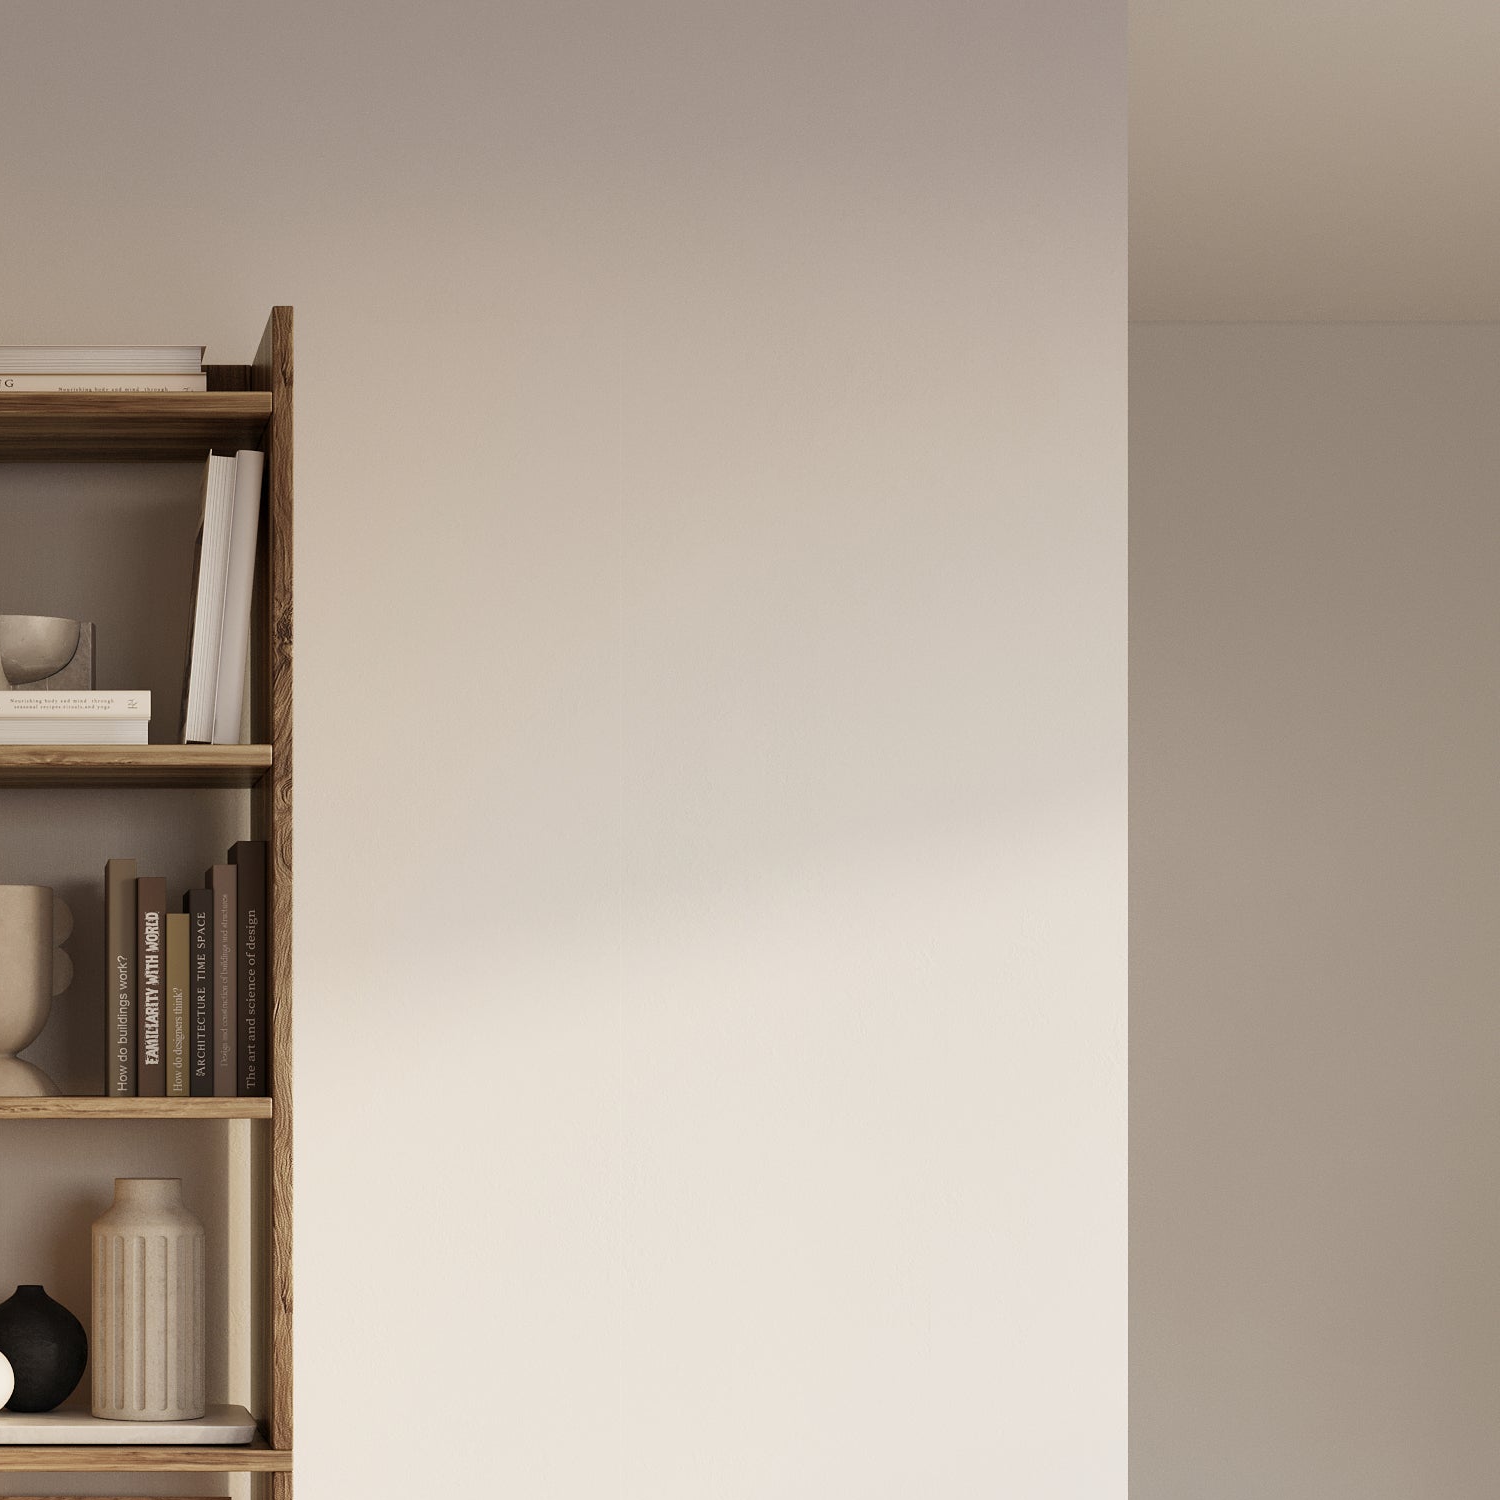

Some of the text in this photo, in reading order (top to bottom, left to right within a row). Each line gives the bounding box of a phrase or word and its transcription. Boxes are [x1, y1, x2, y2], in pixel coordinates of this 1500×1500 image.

[117, 955, 130, 1091] How do buildings work?
[144, 912, 160, 1065] FAMILIARITY WITH WORLD
[172, 987, 185, 1091] How do designers think?
[196, 912, 206, 1077] ARCHITECTURE TIME SPACE
[246, 910, 258, 1089] The art and science of design
